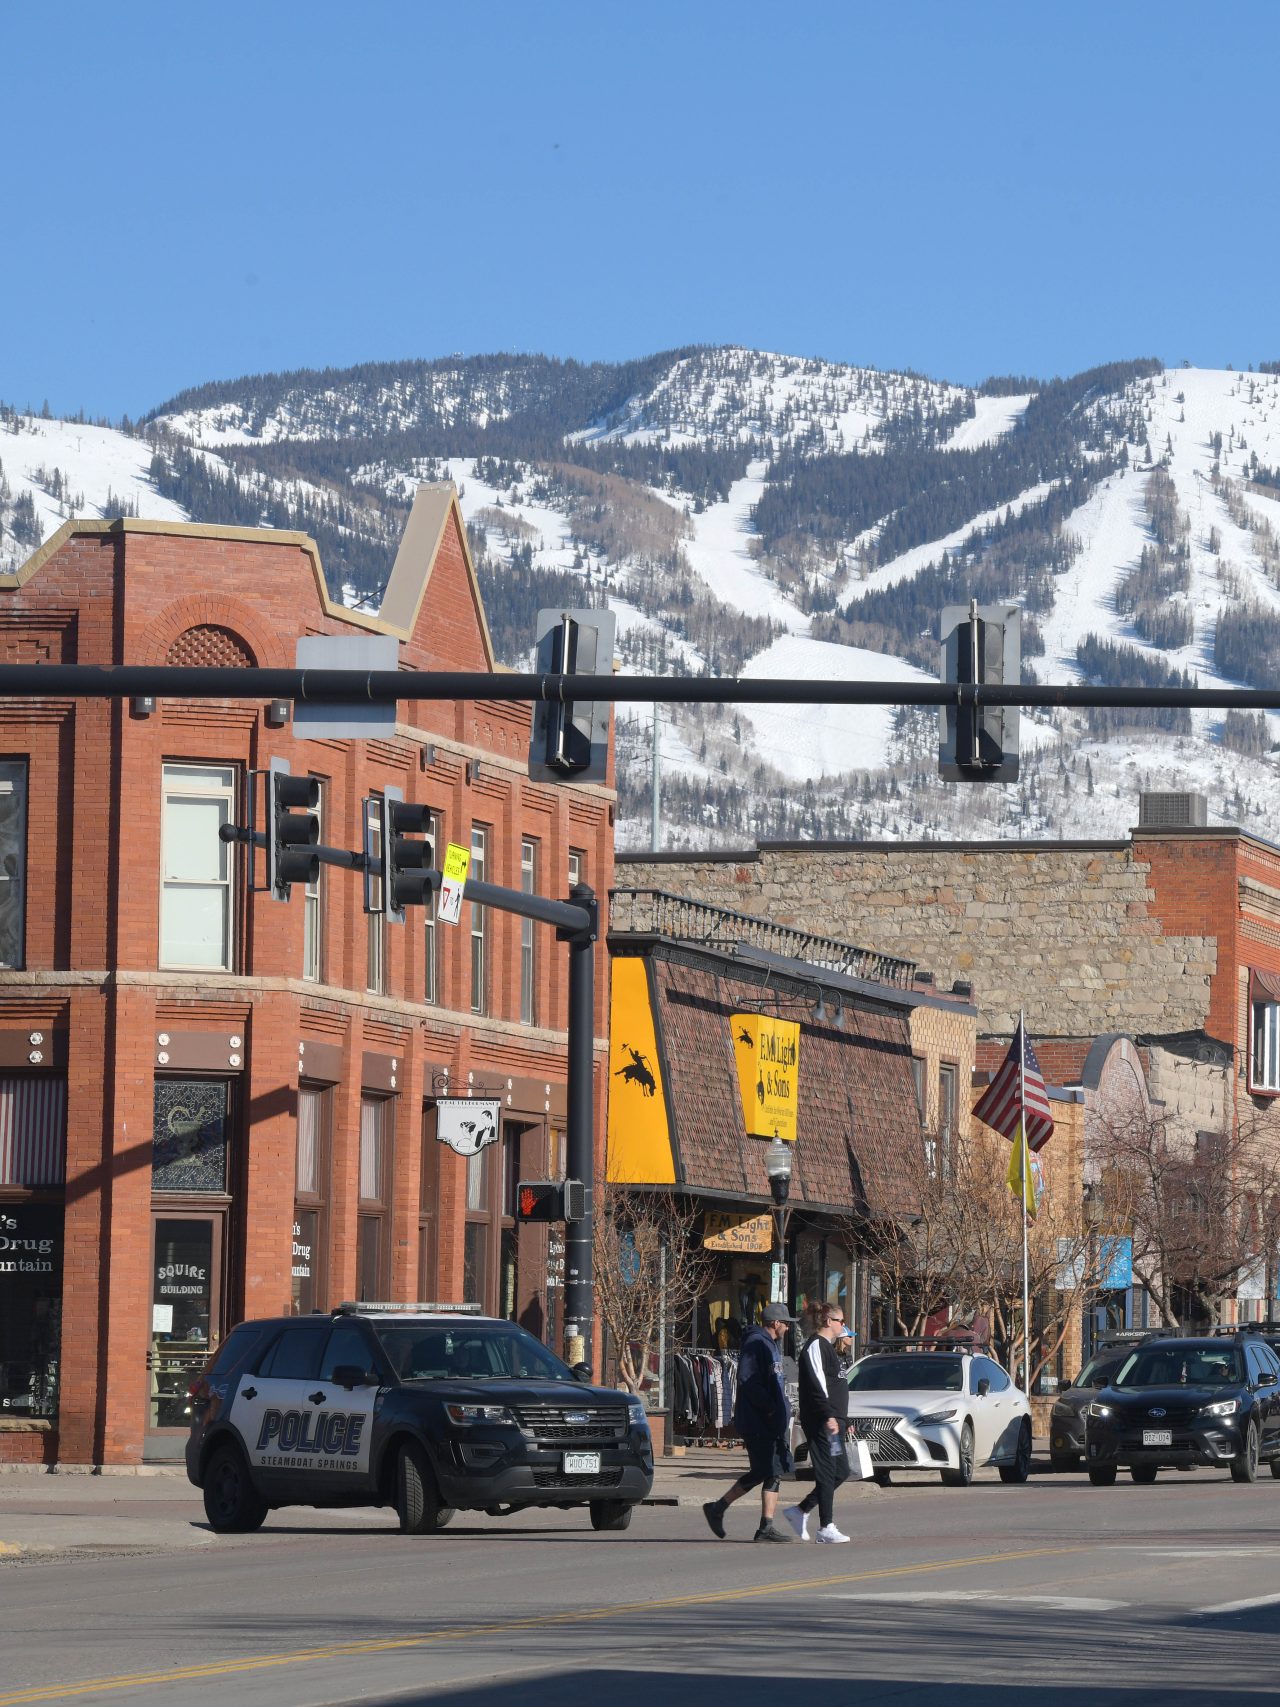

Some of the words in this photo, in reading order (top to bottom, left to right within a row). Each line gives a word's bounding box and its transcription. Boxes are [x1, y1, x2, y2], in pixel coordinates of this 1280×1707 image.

[766, 1071, 773, 1096] &
[774, 1069, 790, 1098] Sons
[731, 1228, 757, 1242] Sons
[292, 1241, 311, 1260] Drug
[158, 1264, 206, 1279] SQUIRE
[160, 1285, 203, 1294] BUILDING
[256, 1408, 367, 1456] POLICE
[261, 1456, 313, 1469] STEAMBOAT
[317, 1459, 359, 1471] SPRINGS
